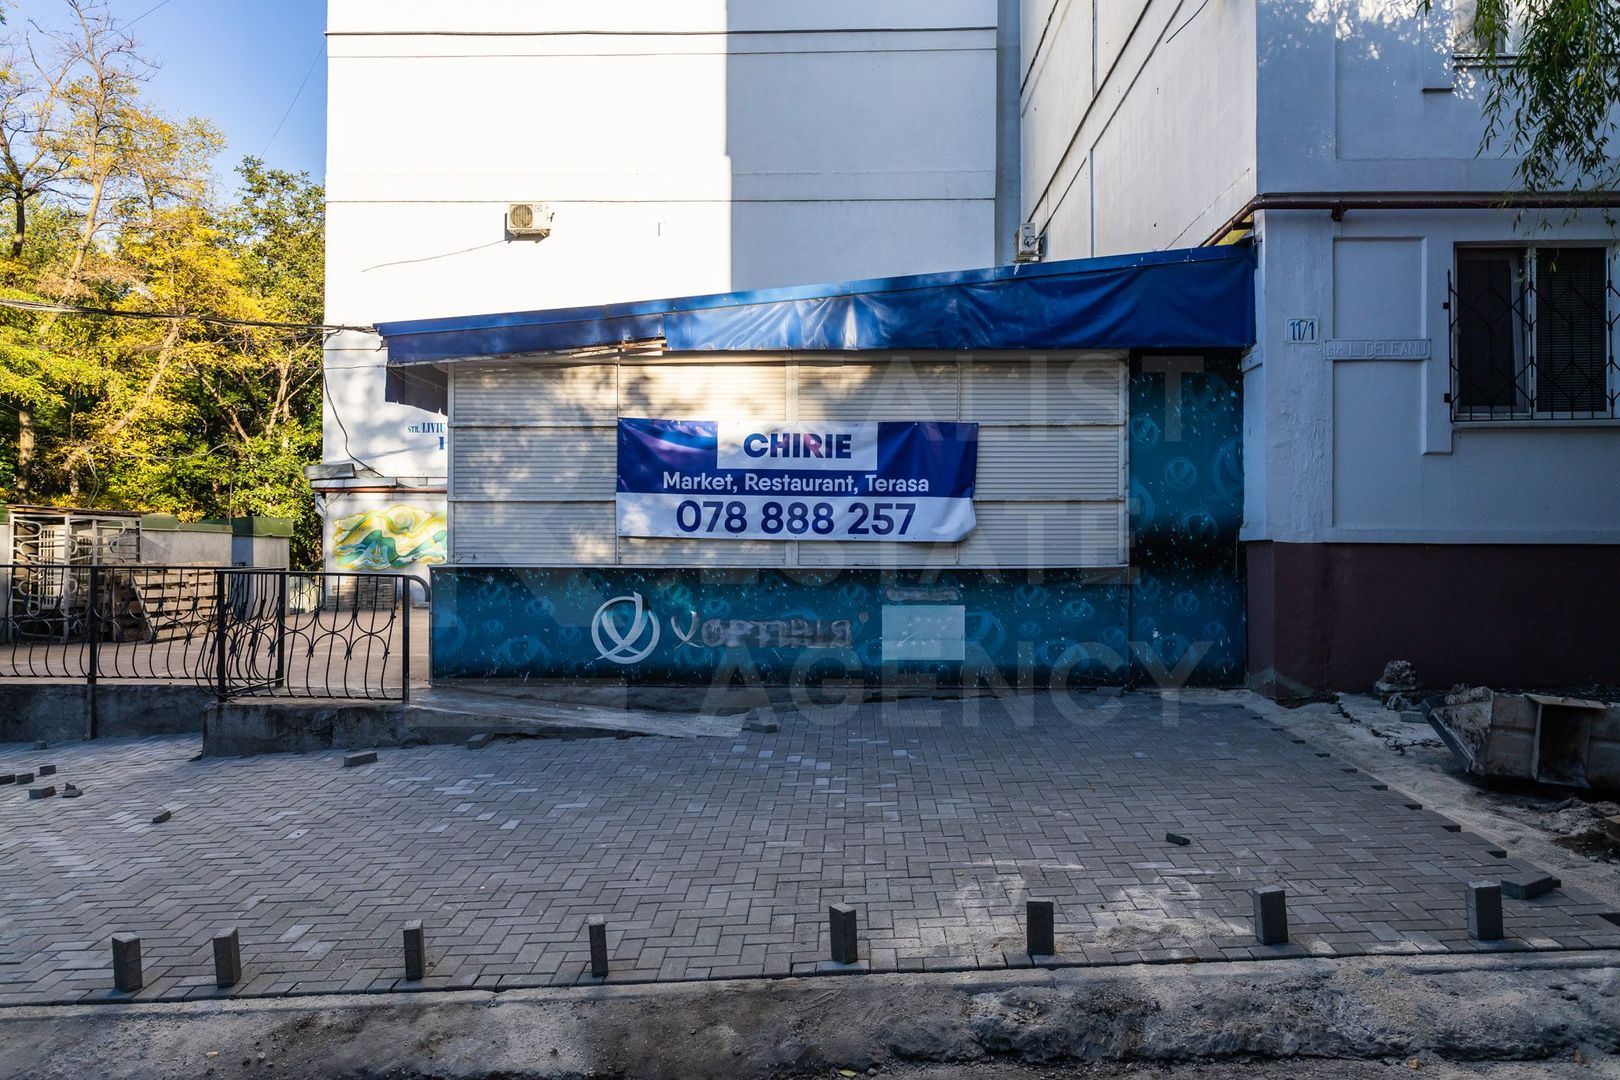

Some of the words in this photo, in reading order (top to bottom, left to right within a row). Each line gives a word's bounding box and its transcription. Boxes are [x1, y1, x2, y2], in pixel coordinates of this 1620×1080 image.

[408, 425, 421, 434] STR.
[422, 422, 446, 434] LIVIU
[743, 432, 852, 460] CHIRIE
[662, 471, 738, 494] Market,
[744, 473, 859, 495] Restaurant,
[864, 474, 930, 493] Terasa
[676, 500, 748, 533] 078
[761, 502, 835, 535] 888
[847, 503, 916, 536] 257
